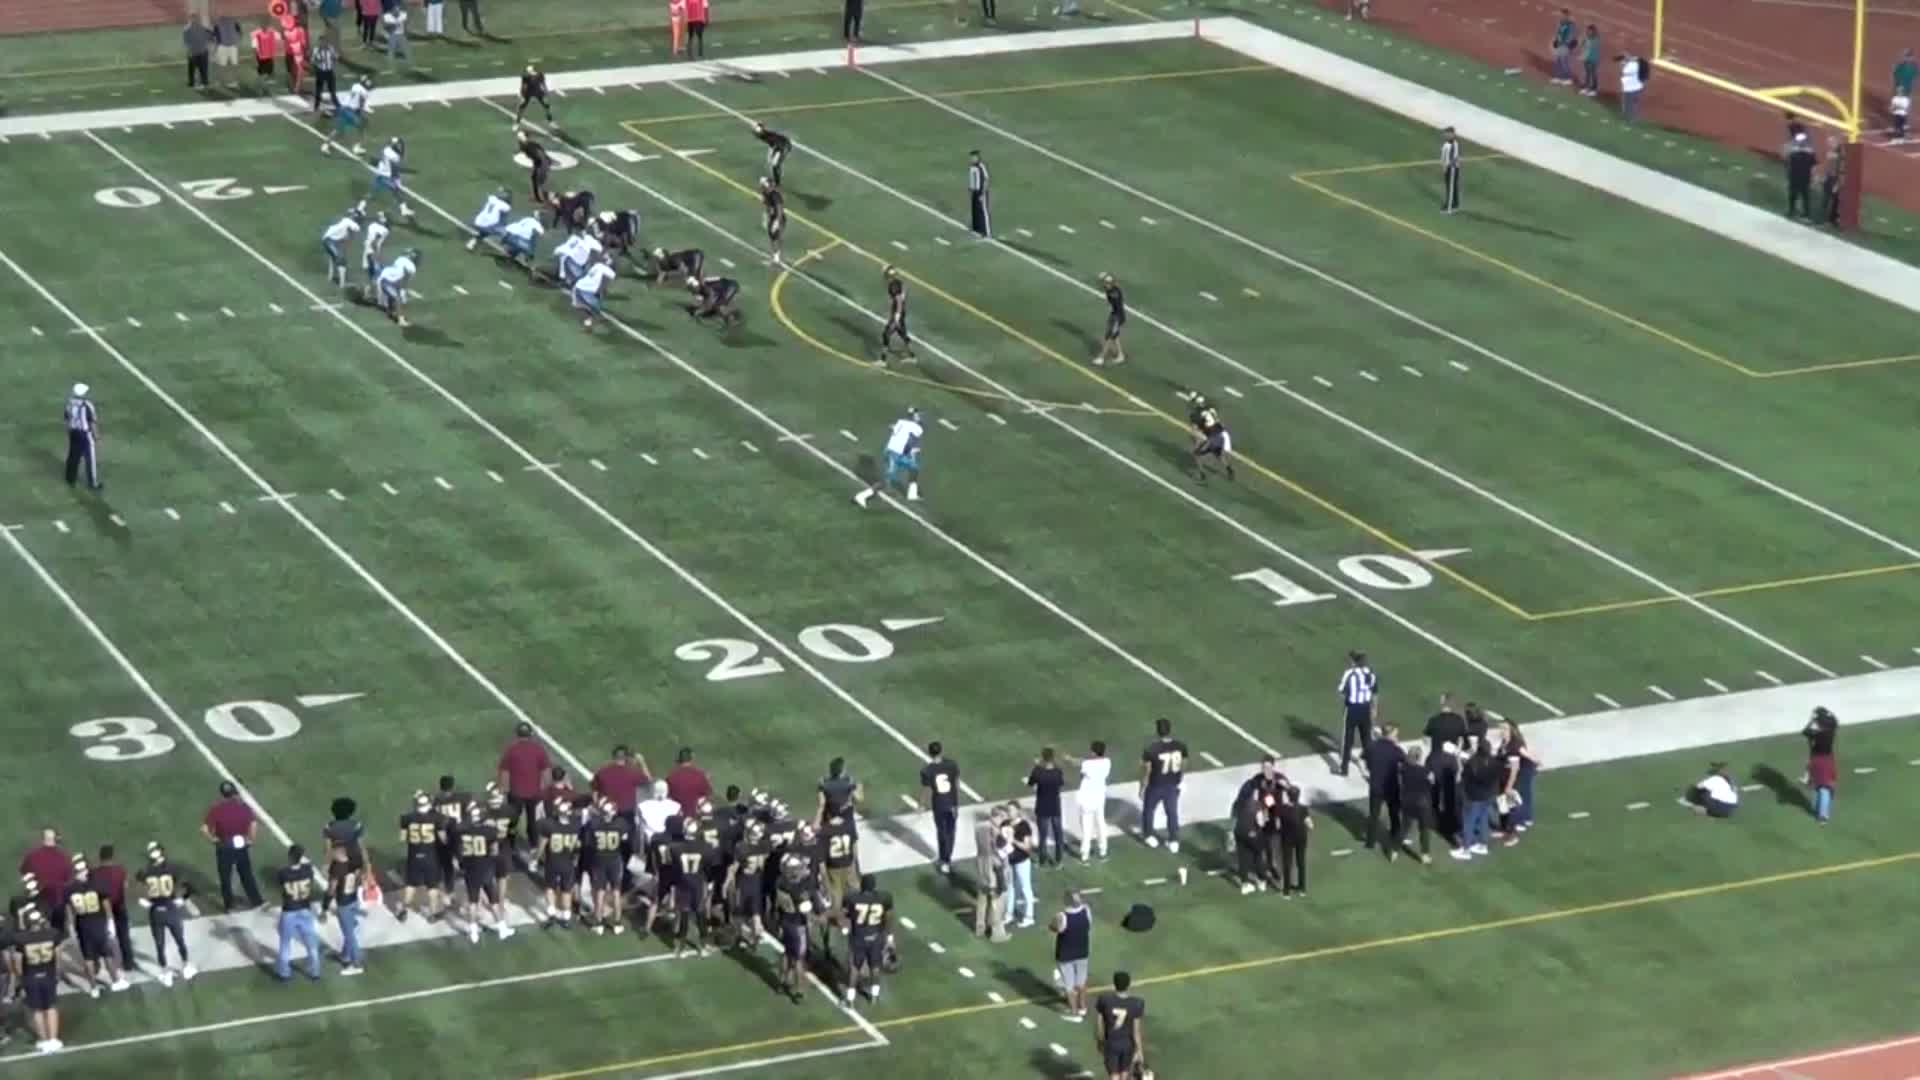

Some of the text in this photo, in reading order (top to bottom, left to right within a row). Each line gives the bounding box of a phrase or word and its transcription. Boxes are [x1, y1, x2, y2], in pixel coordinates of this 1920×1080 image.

[1231, 554, 1433, 606] 10
[674, 623, 894, 681] 20
[69, 700, 302, 760] 30
[935, 774, 951, 793] 6
[829, 833, 851, 858] 21
[680, 852, 702, 875] 17
[854, 903, 884, 926] 72
[24, 940, 55, 965] 55
[1111, 1008, 1129, 1031] 7
